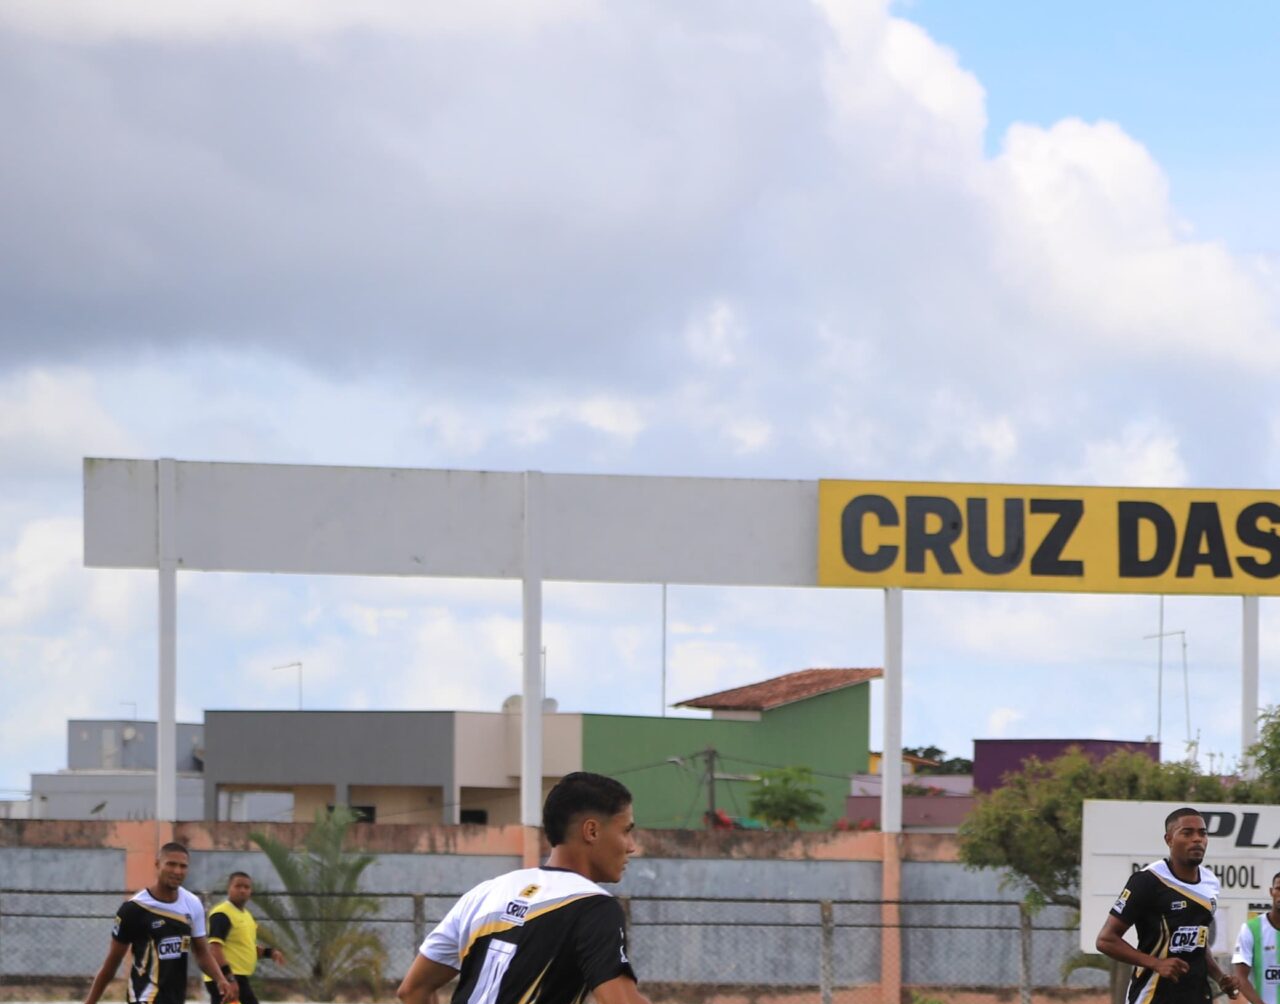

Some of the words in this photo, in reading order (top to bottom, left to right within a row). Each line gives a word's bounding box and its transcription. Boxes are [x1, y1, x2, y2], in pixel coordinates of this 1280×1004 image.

[841, 494, 1085, 577] CRUZ
[1205, 864, 1261, 889] HOOL
[160, 942, 182, 955] CRUZ
